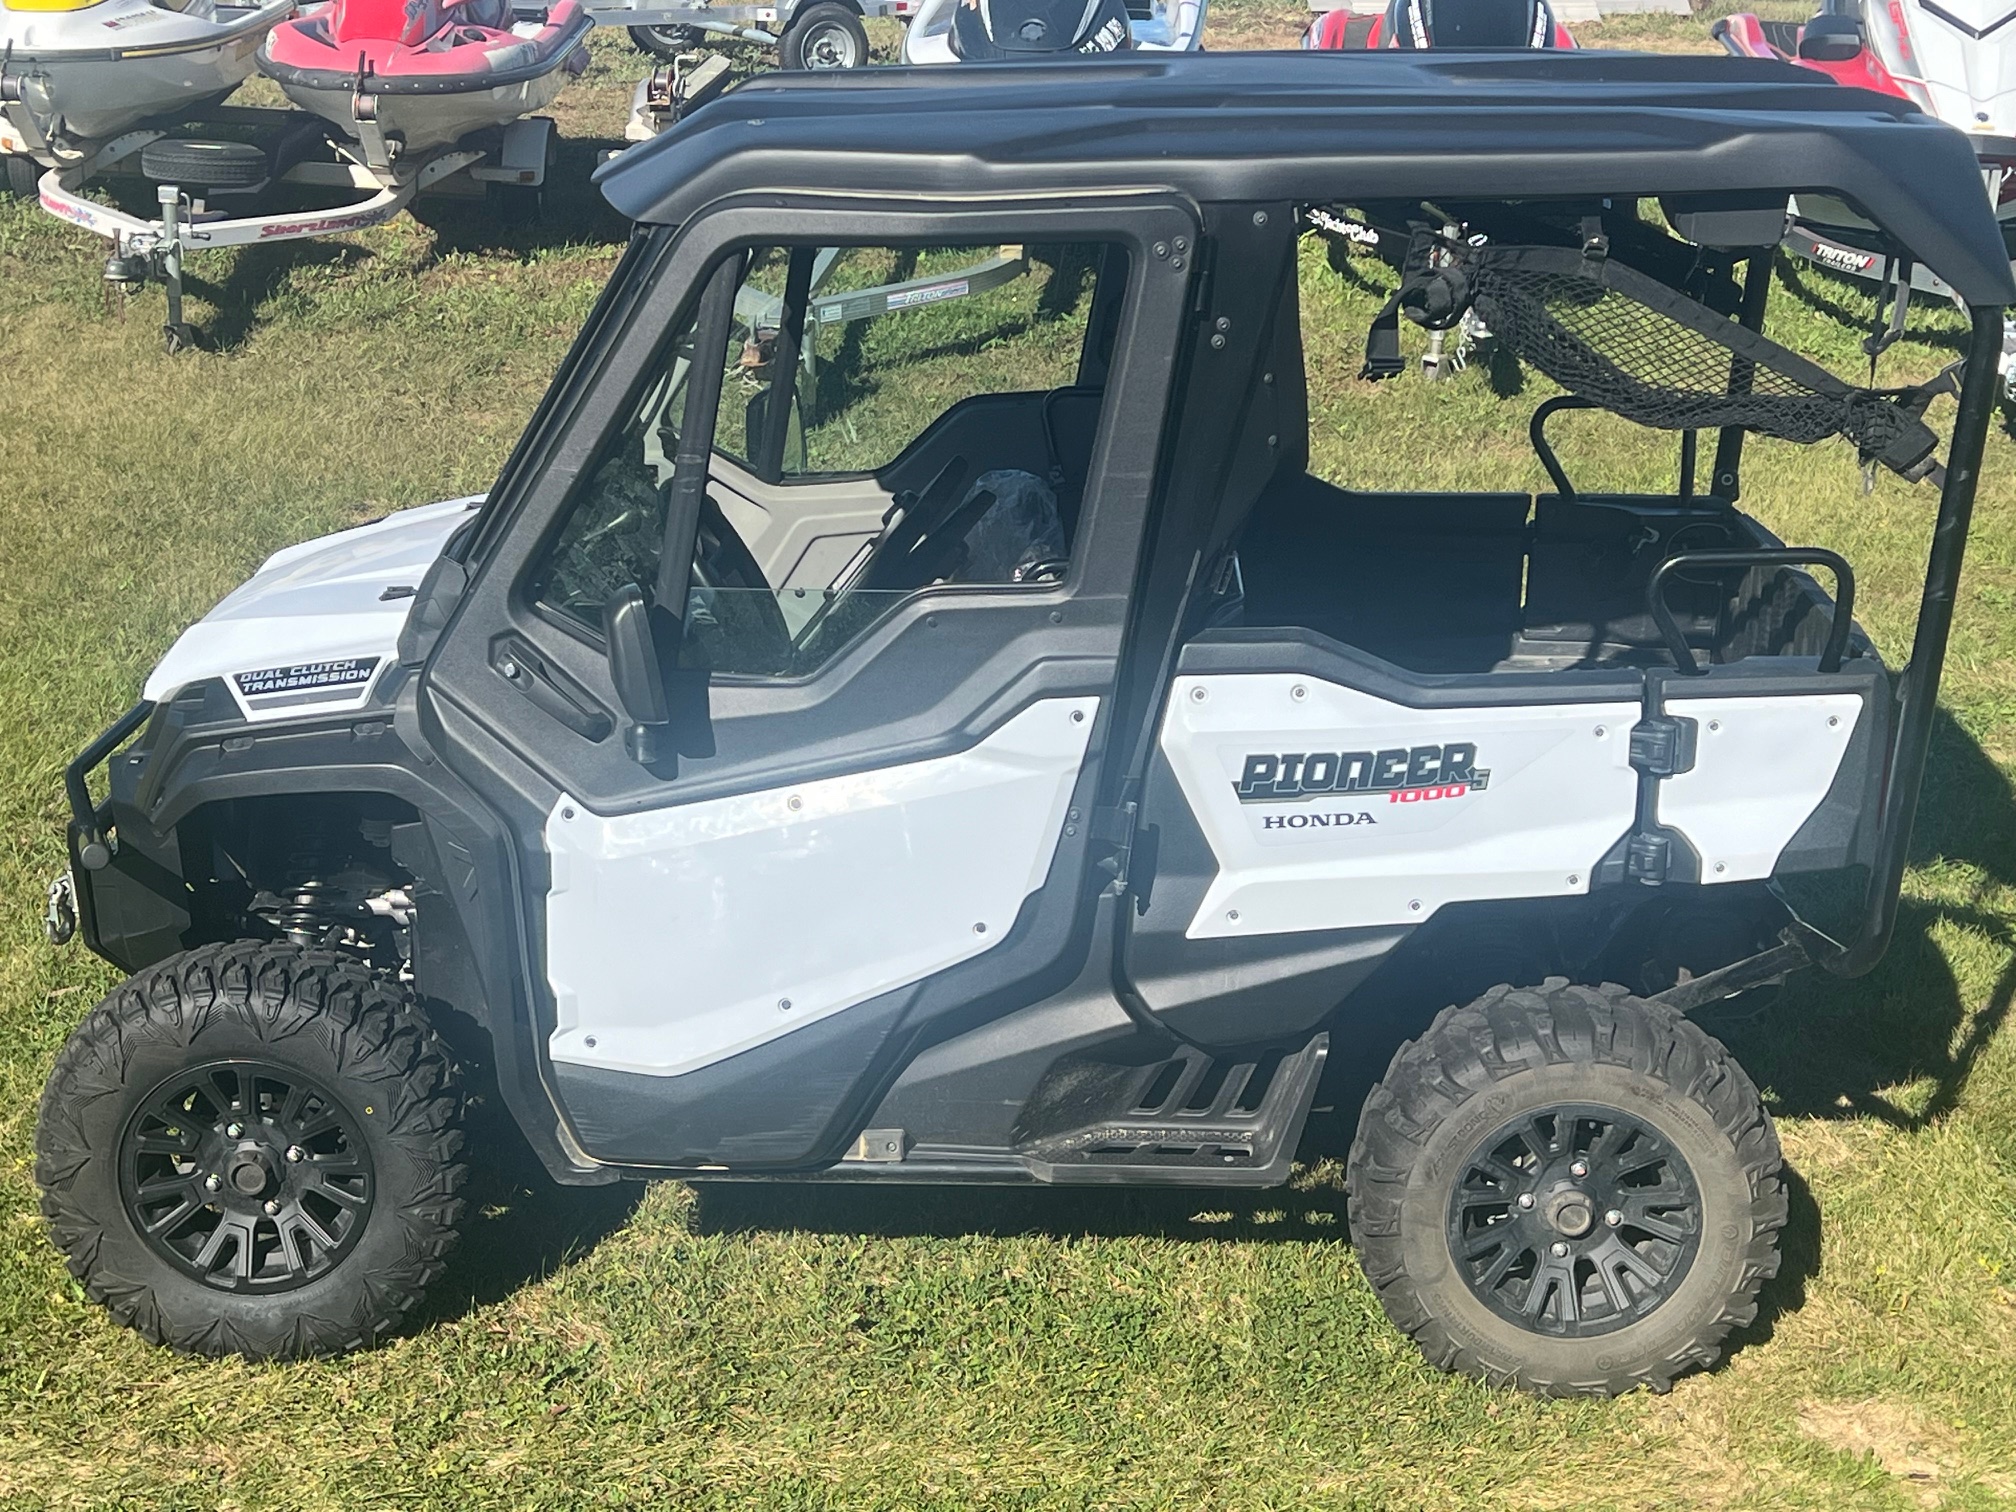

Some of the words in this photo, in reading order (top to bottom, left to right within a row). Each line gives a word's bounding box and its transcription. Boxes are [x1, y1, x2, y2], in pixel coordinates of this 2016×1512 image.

[1816, 243, 1870, 268] TRITON
[904, 290, 944, 305] TRITON
[240, 669, 284, 683] DUAL
[289, 660, 357, 676] CLUTCH
[242, 668, 371, 692] TRANSMISSION
[1238, 742, 1477, 794] PIONEER
[1389, 784, 1467, 803] 1000
[1263, 812, 1378, 829] HONDA
